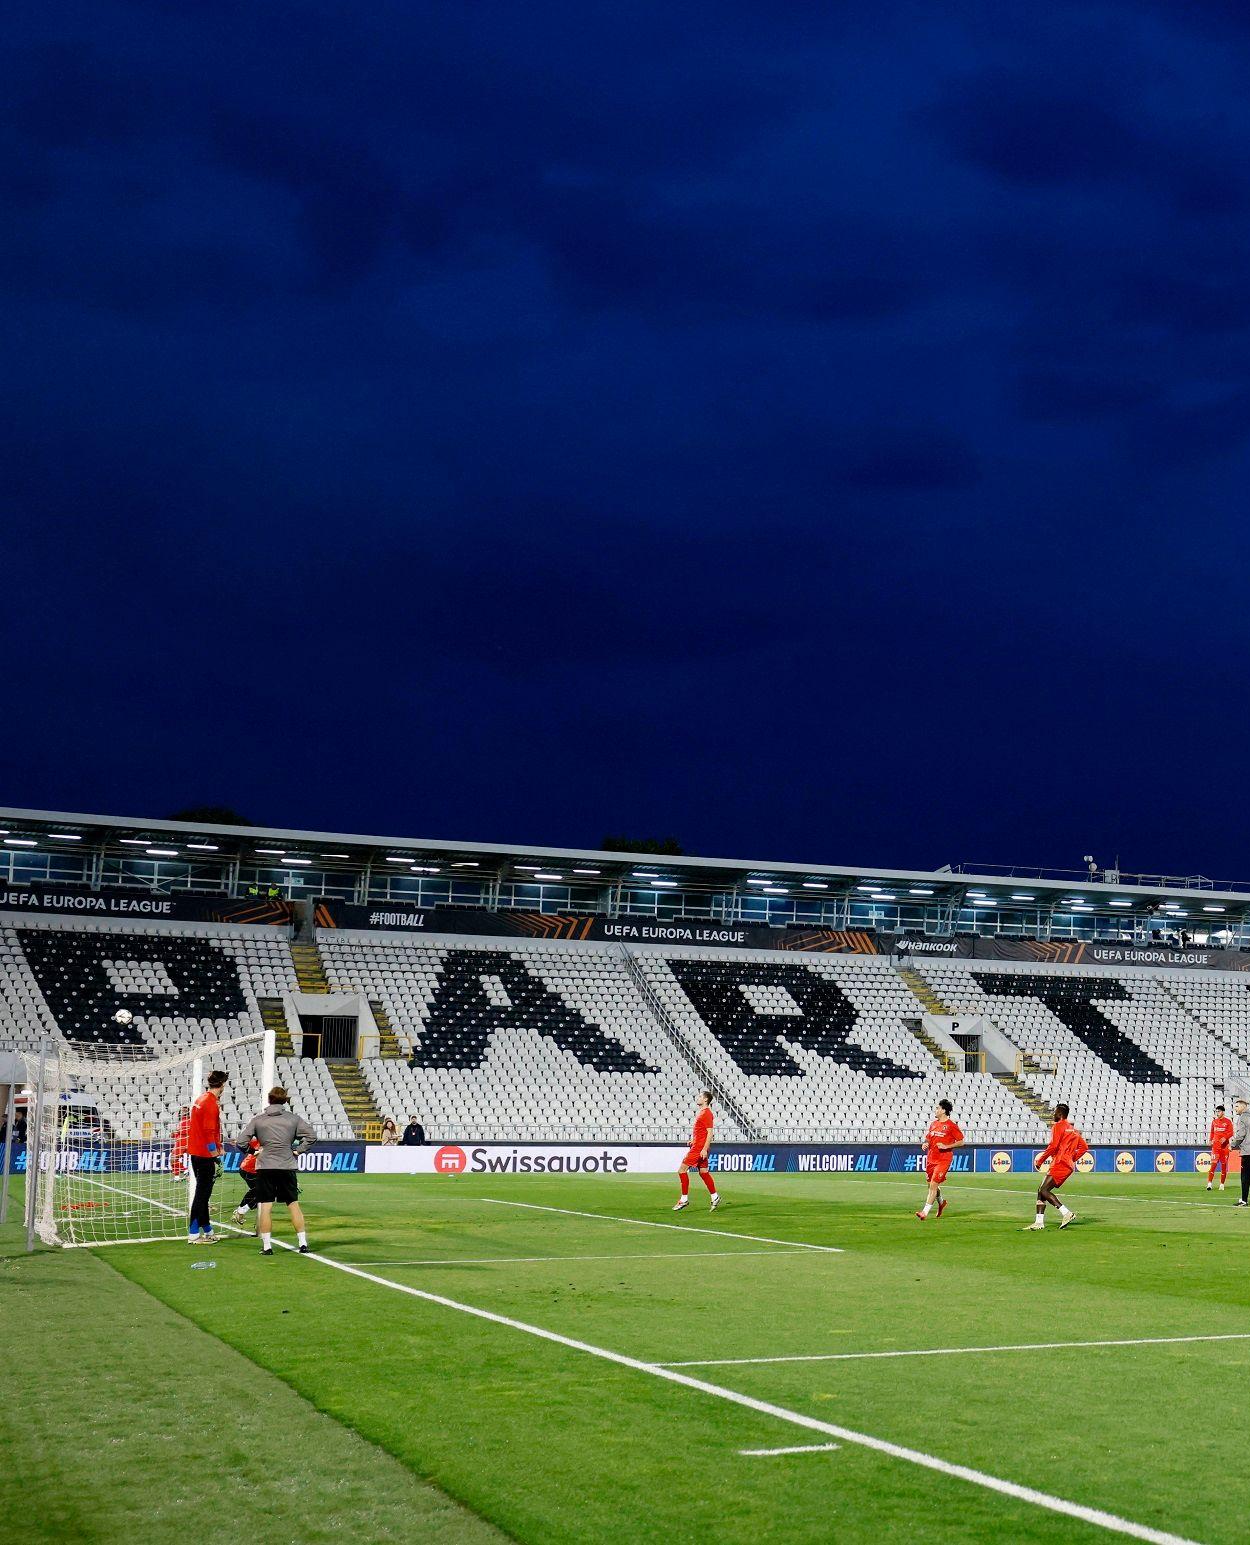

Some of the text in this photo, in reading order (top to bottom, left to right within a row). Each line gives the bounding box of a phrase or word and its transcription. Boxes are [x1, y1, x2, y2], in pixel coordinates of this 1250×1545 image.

[43, 895, 107, 910] EUROPA
[111, 899, 171, 913] LEAGUE
[369, 912, 425, 927] #FOOTBALL
[604, 924, 745, 943] UEFA EUROPA LEAGUE
[1093, 949, 1208, 964] UEFA EUROPA LEAGUE
[951, 1022, 960, 1031] P
[298, 1152, 358, 1171] OOTBALL
[471, 1148, 628, 1173] Swissquote
[708, 1154, 775, 1171] #FOOTBALL
[798, 1154, 878, 1171] WELCOME ALL
